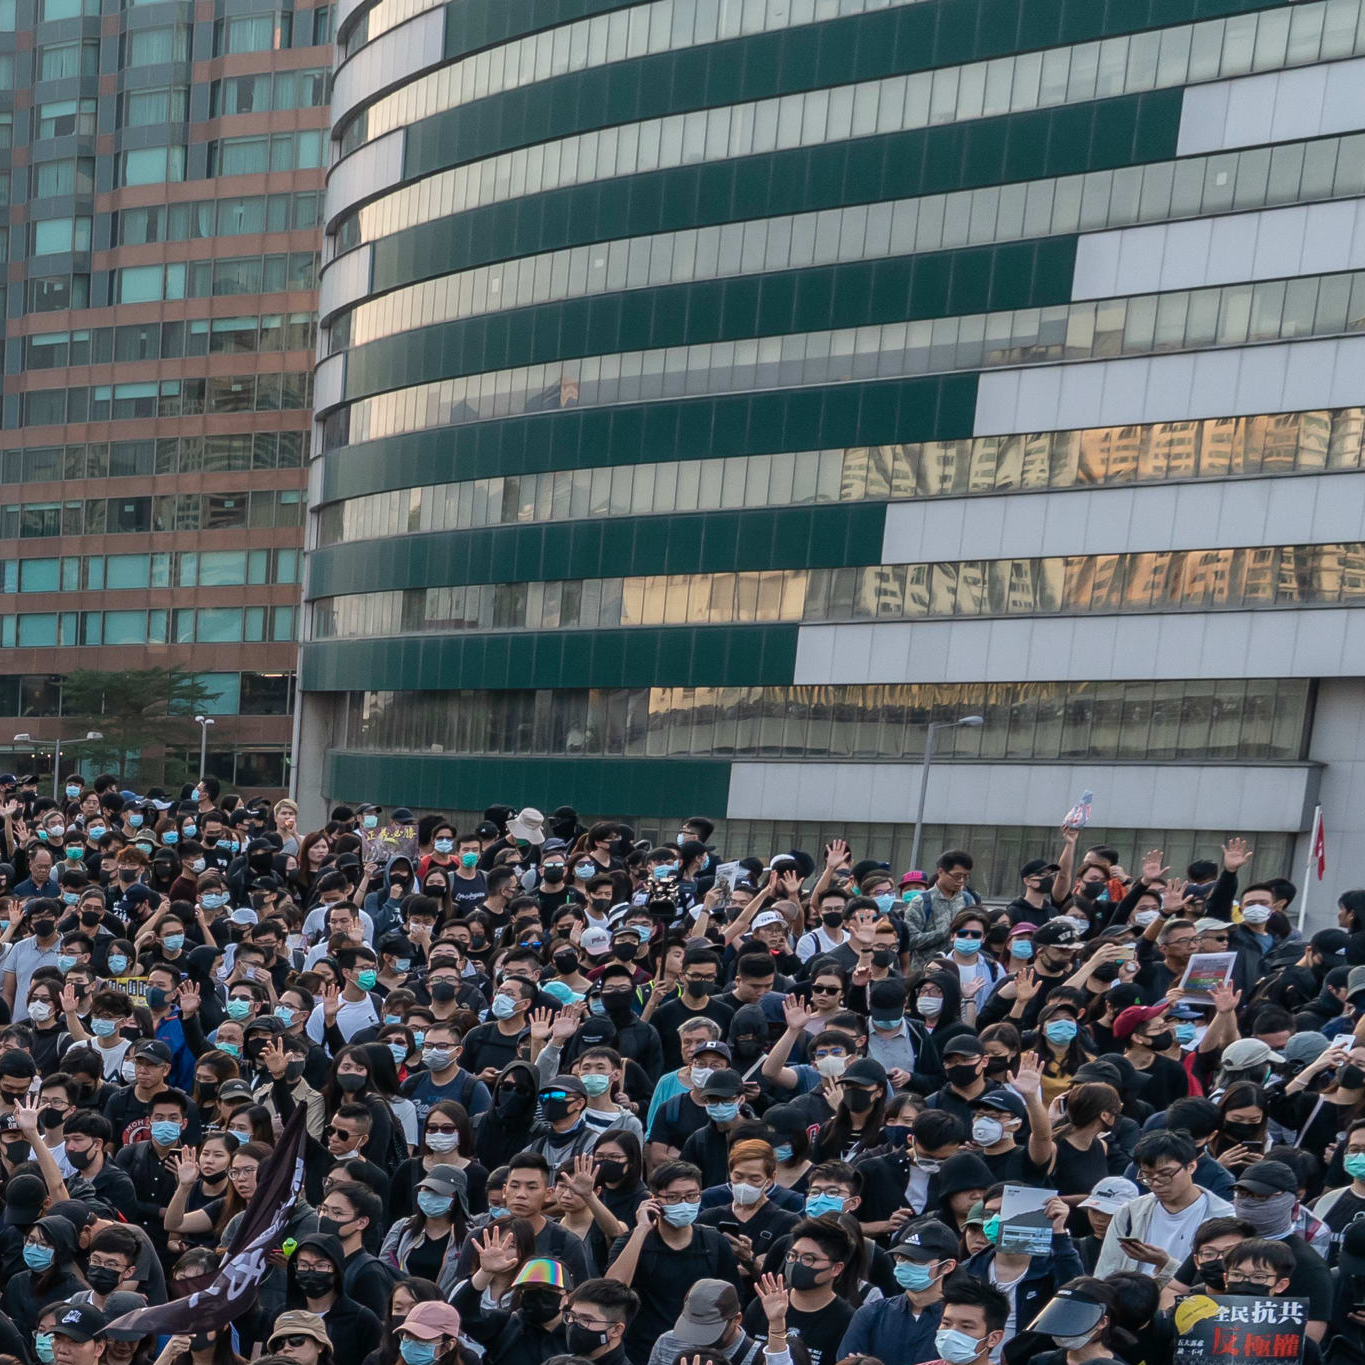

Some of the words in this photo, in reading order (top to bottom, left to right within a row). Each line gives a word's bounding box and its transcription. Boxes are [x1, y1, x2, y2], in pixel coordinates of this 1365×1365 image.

[1213, 1301, 1304, 1325] 全民抗共
[1212, 1327, 1300, 1358] 反極權
